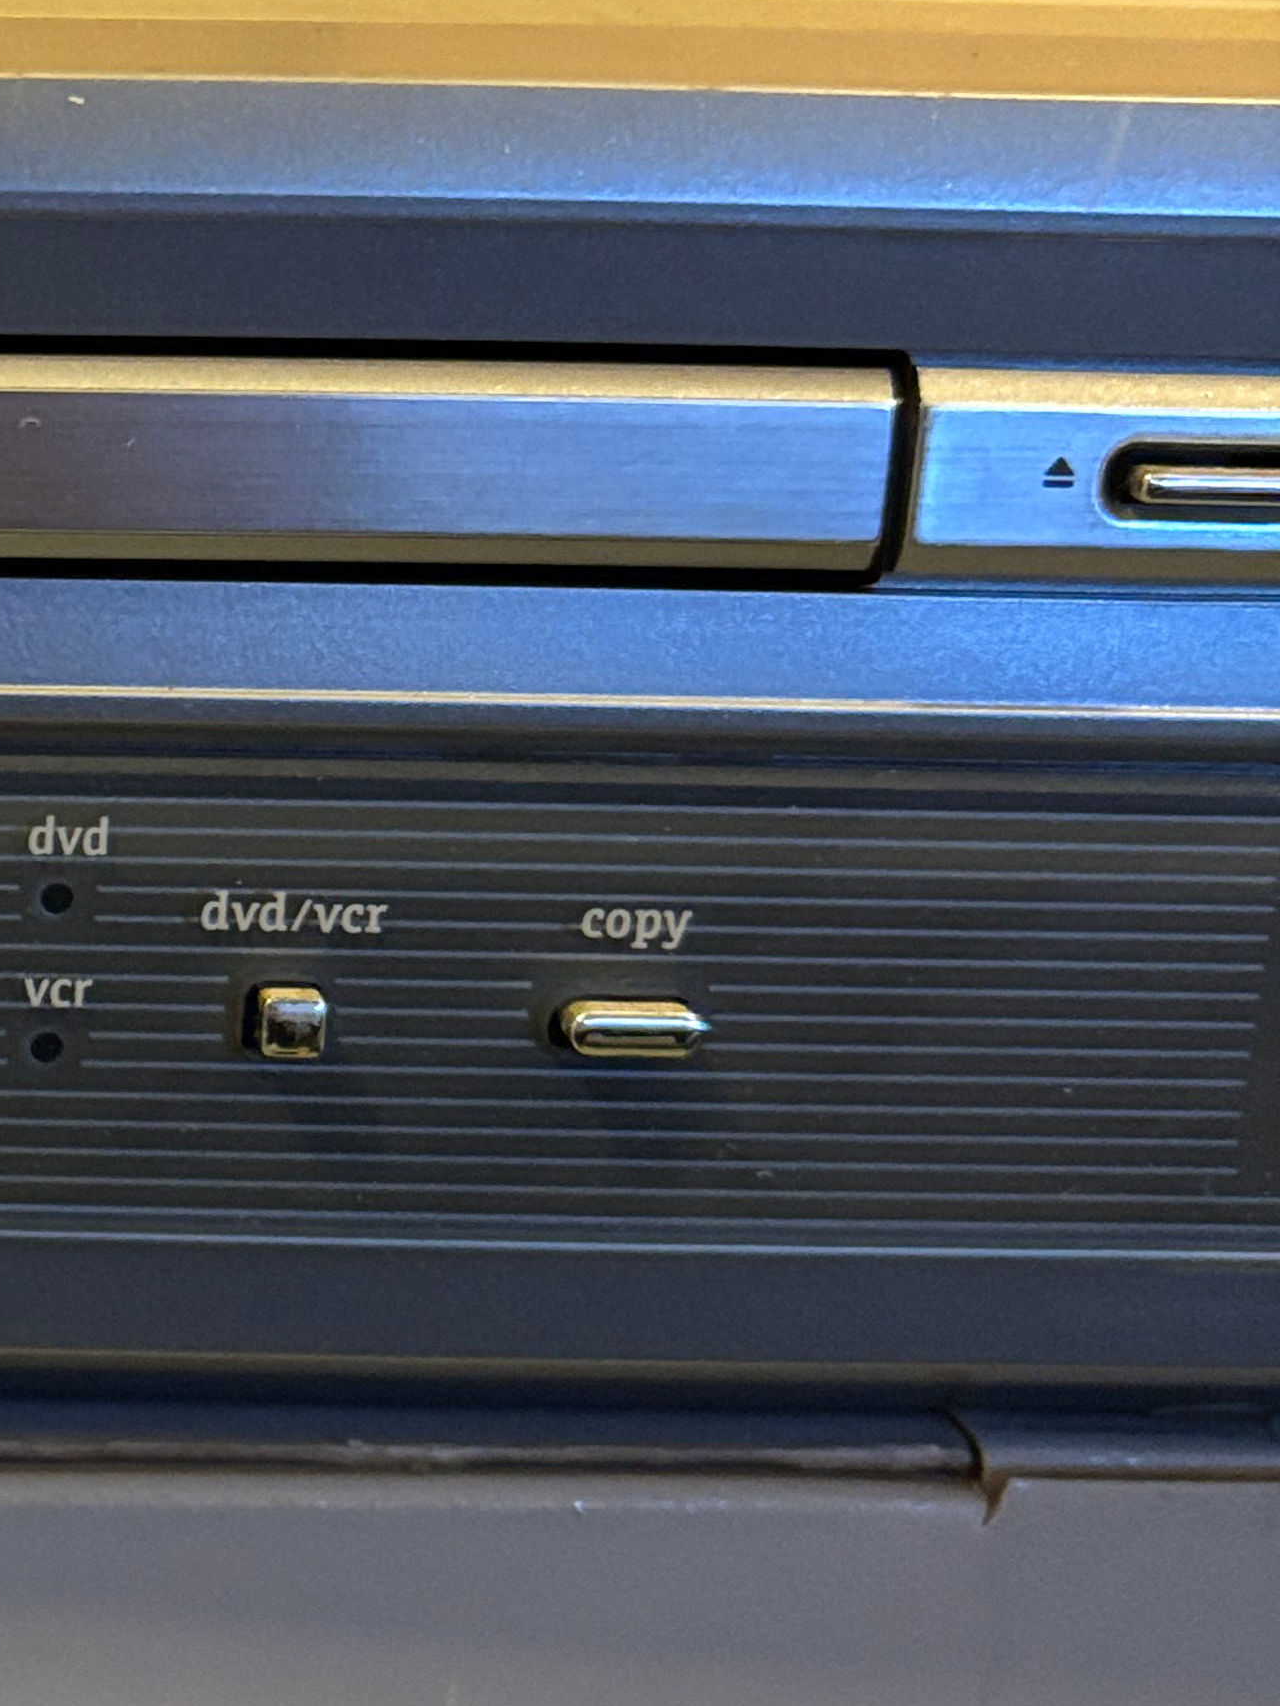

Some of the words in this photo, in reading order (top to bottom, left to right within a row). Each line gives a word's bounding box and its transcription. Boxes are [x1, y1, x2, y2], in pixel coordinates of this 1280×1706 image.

[28, 815, 109, 856] dvd
[200, 890, 388, 934] dvd/vcr
[580, 906, 693, 949] copy
[25, 976, 93, 1009] vcr
